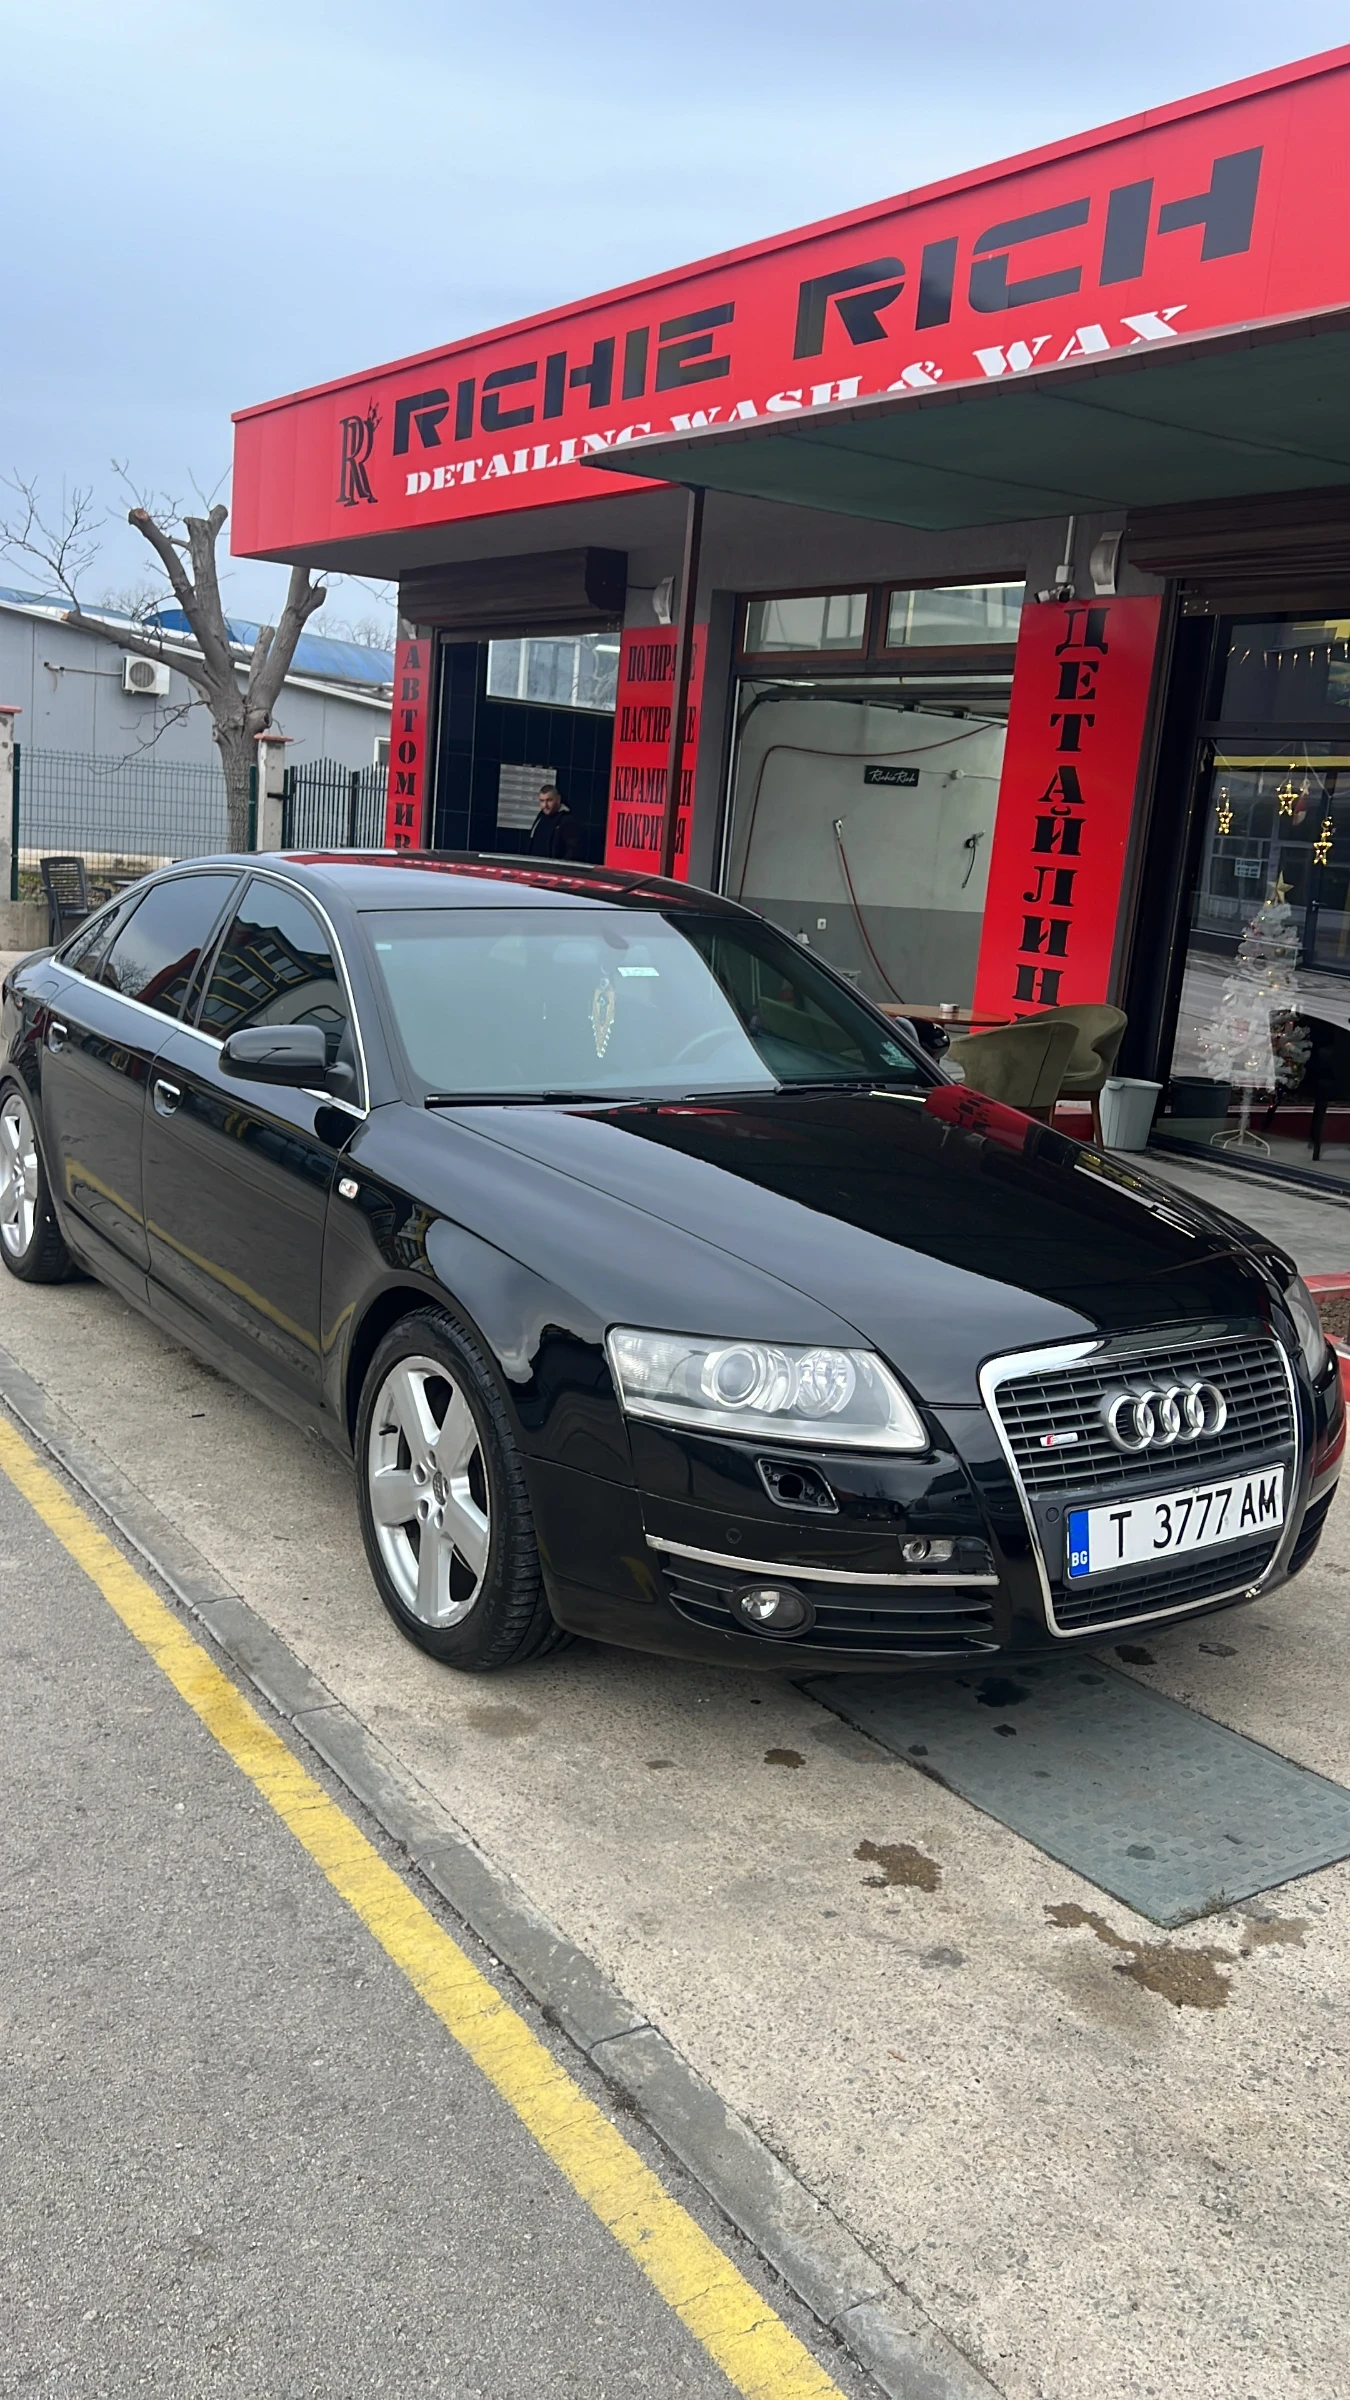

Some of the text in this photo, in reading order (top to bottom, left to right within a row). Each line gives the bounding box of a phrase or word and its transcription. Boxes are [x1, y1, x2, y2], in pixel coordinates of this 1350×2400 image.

[393, 145, 1264, 456] RICHIE RICH
[972, 304, 1188, 377] WAX
[620, 706, 697, 743] ПАСТИРЕ
[614, 766, 693, 806] КЕРАМИИ
[1012, 608, 1111, 1021] ДЕТАЙЛИН
[615, 812, 686, 855] ПОКРИЯ
[1109, 1476, 1277, 1558] T 3777 AM
[1071, 1550, 1088, 1566] BG
